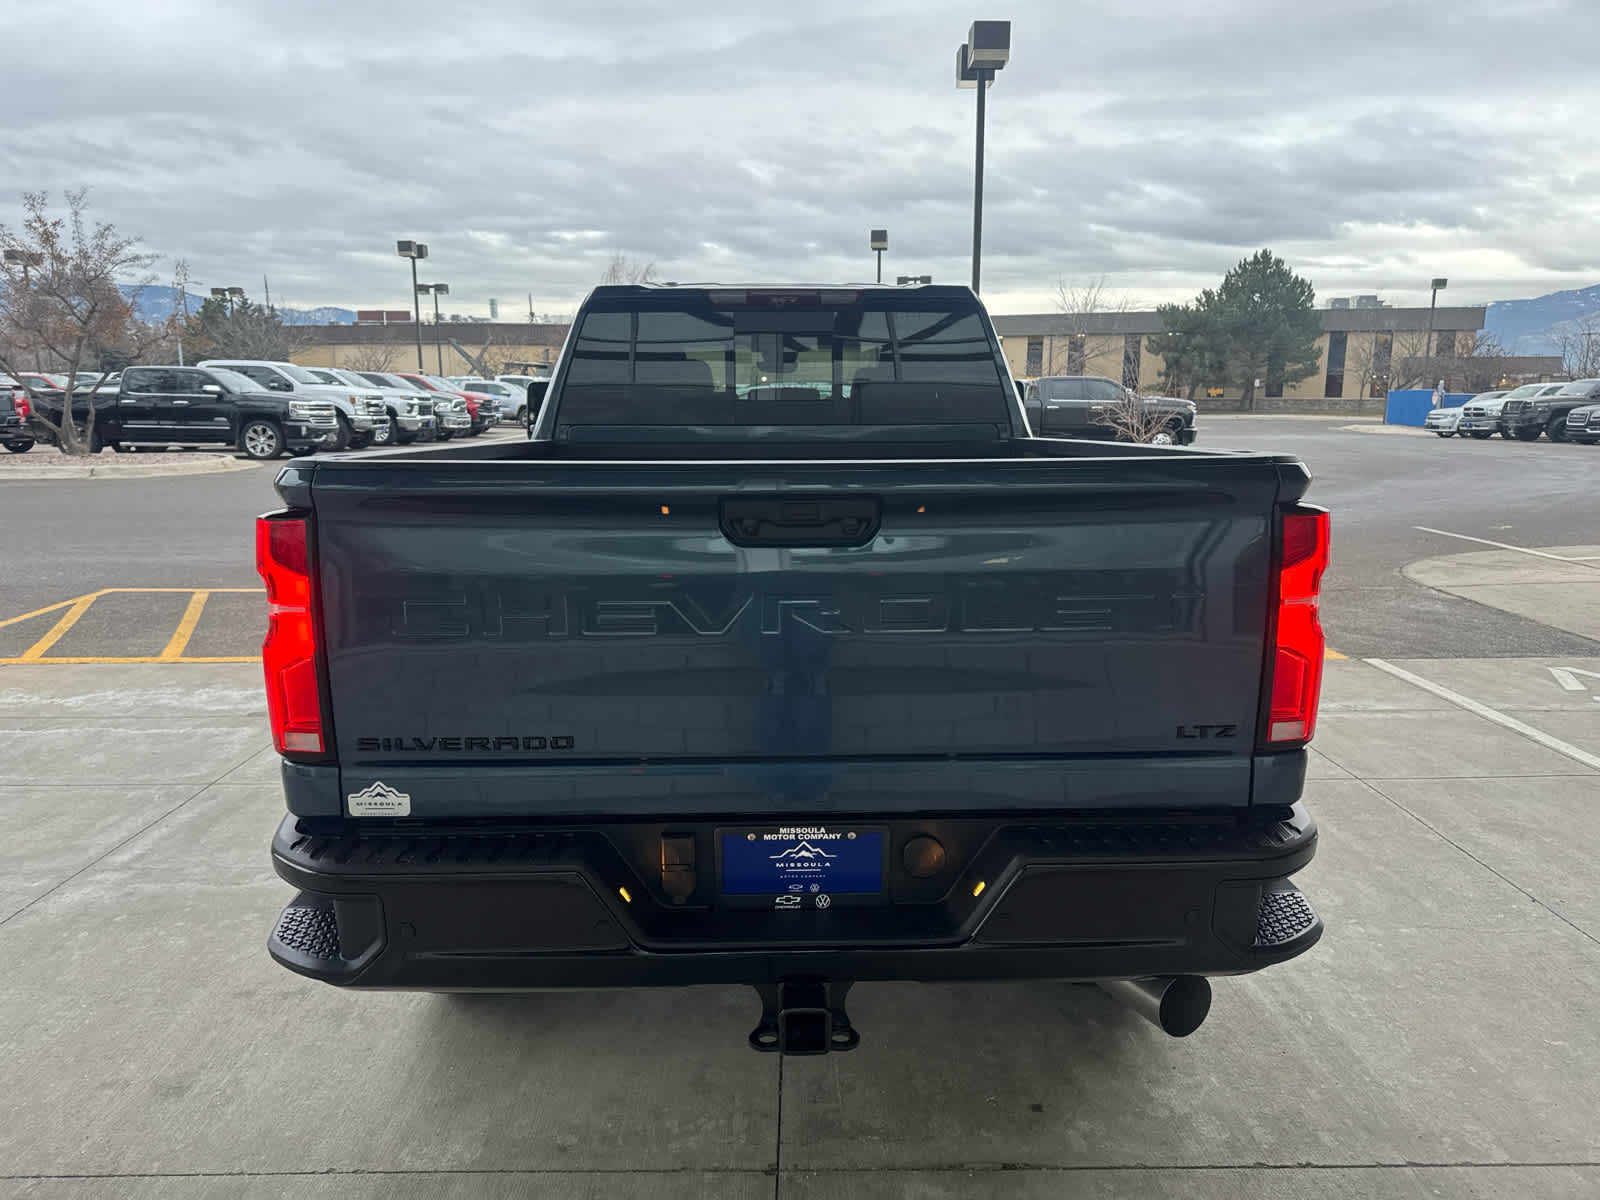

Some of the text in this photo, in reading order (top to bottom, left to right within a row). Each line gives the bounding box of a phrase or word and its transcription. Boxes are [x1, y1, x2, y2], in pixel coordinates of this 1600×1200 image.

[392, 592, 1206, 636] CHEVROLET
[1176, 724, 1237, 738] LTZ
[355, 736, 575, 752] SILVERADO
